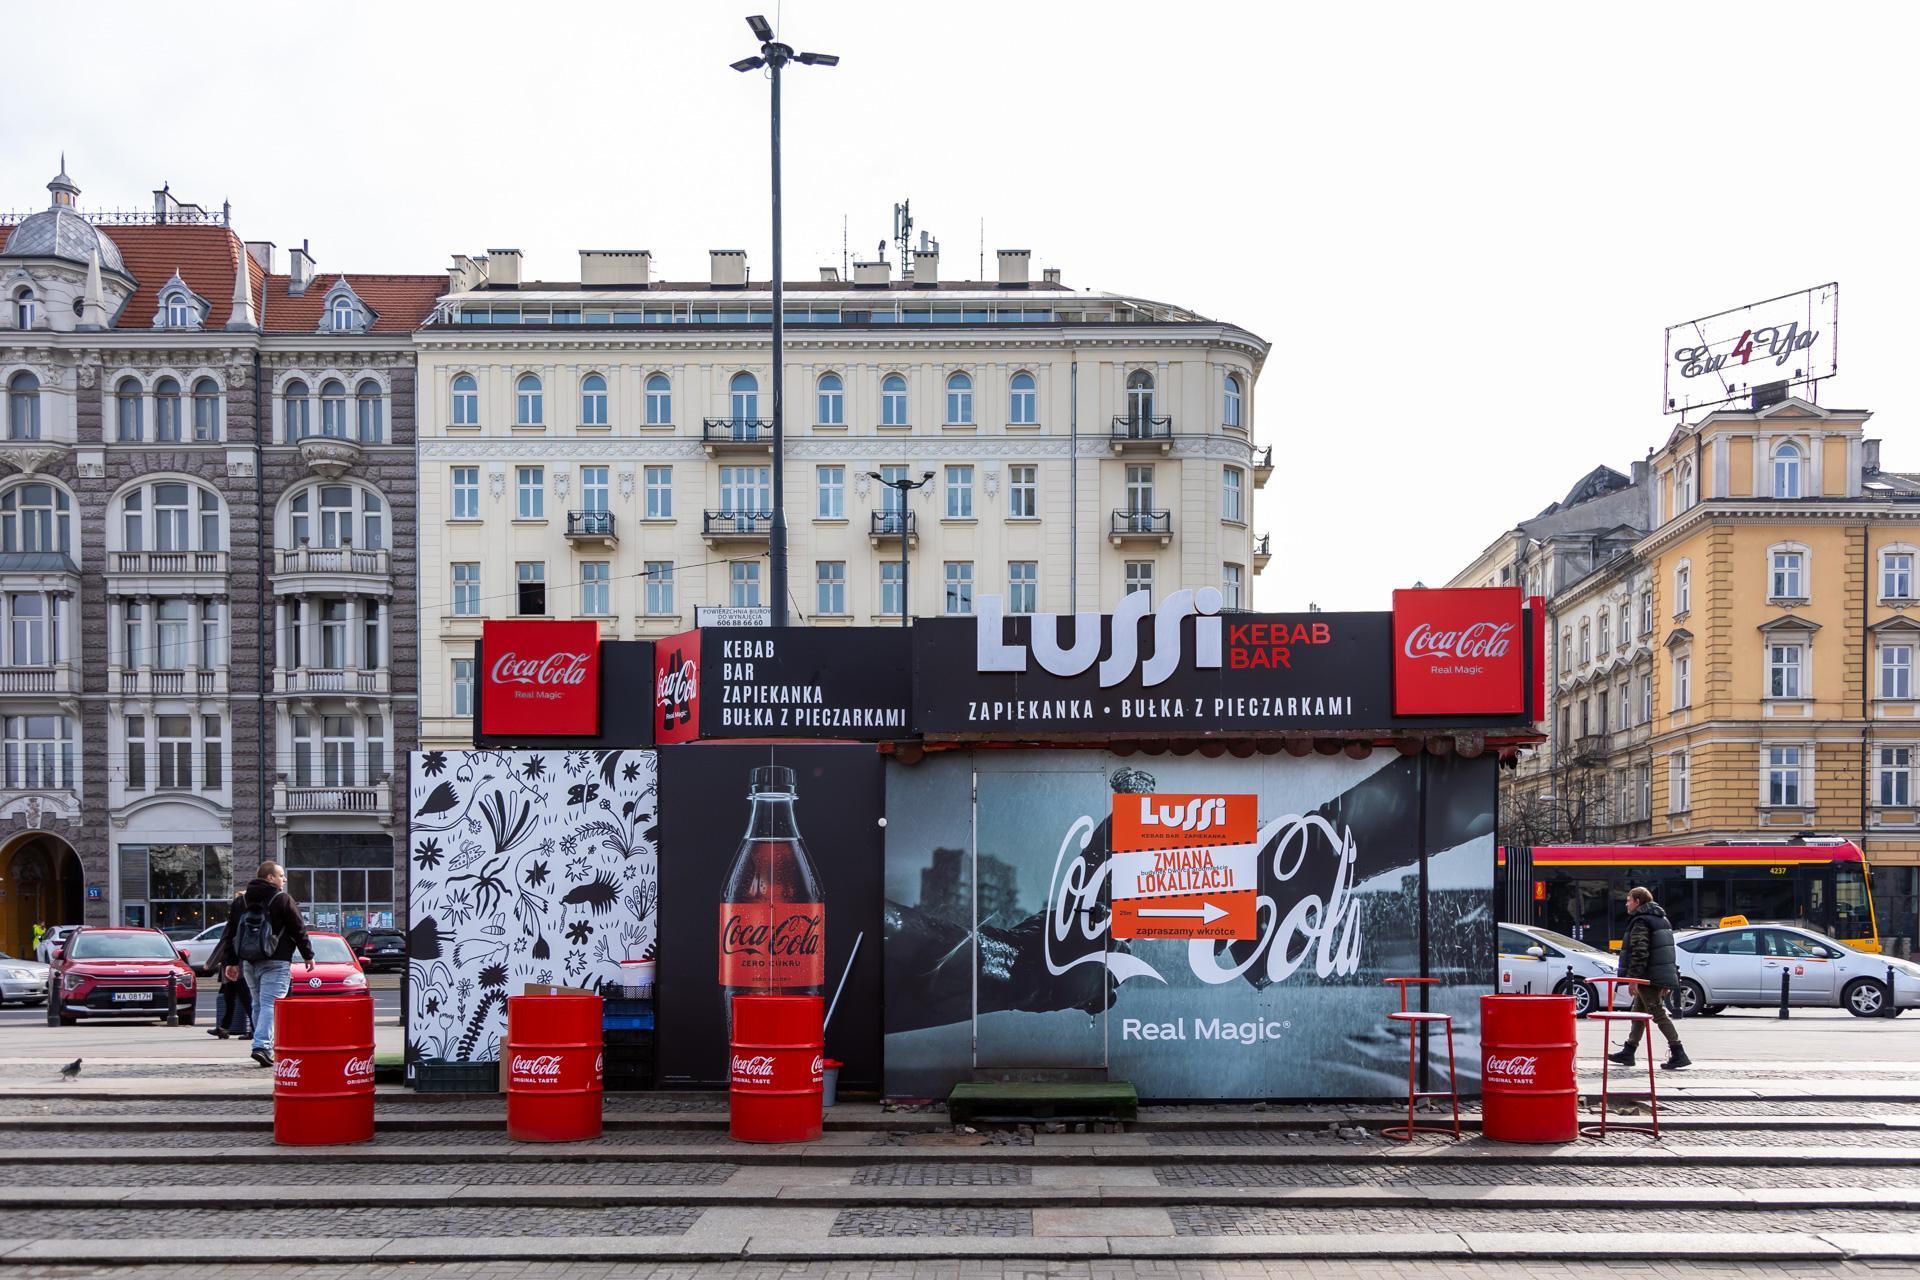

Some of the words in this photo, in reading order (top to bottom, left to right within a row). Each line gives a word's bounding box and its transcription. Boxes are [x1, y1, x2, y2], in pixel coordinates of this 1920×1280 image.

[1230, 623, 1331, 645] KEBAB
[1405, 622, 1516, 658] Coca-Cola
[723, 640, 775, 658] KEBAB
[1230, 647, 1292, 669] BAR
[491, 652, 592, 684] Coca-Cola
[723, 663, 754, 681] BAR
[1431, 666, 1452, 674] Real
[1454, 665, 1484, 675] Magic
[514, 691, 534, 699] Real
[722, 686, 823, 703] ZAPIEKANKA
[722, 708, 774, 726] BUŁKA
[780, 709, 789, 726] Z
[796, 709, 906, 727] PIECZARKAMI
[968, 700, 1094, 721] ZAPIEKANKA
[1122, 698, 1184, 718] BUŁKA
[1195, 698, 1204, 717] Z
[1214, 696, 1352, 717] PIECZARKAMI
[1154, 850, 1214, 872] ZMIANA
[1137, 869, 1234, 894] LOKALIZACJI
[723, 915, 821, 956] Coca-Cola
[1136, 928, 1195, 937] zapraszamy
[1196, 927, 1236, 935] wkrótce
[1122, 1018, 1186, 1040] Real
[512, 1055, 564, 1075] Coca-Cola
[732, 1055, 776, 1076] Coca-Cola
[1487, 1055, 1538, 1075] Coca-Cola
